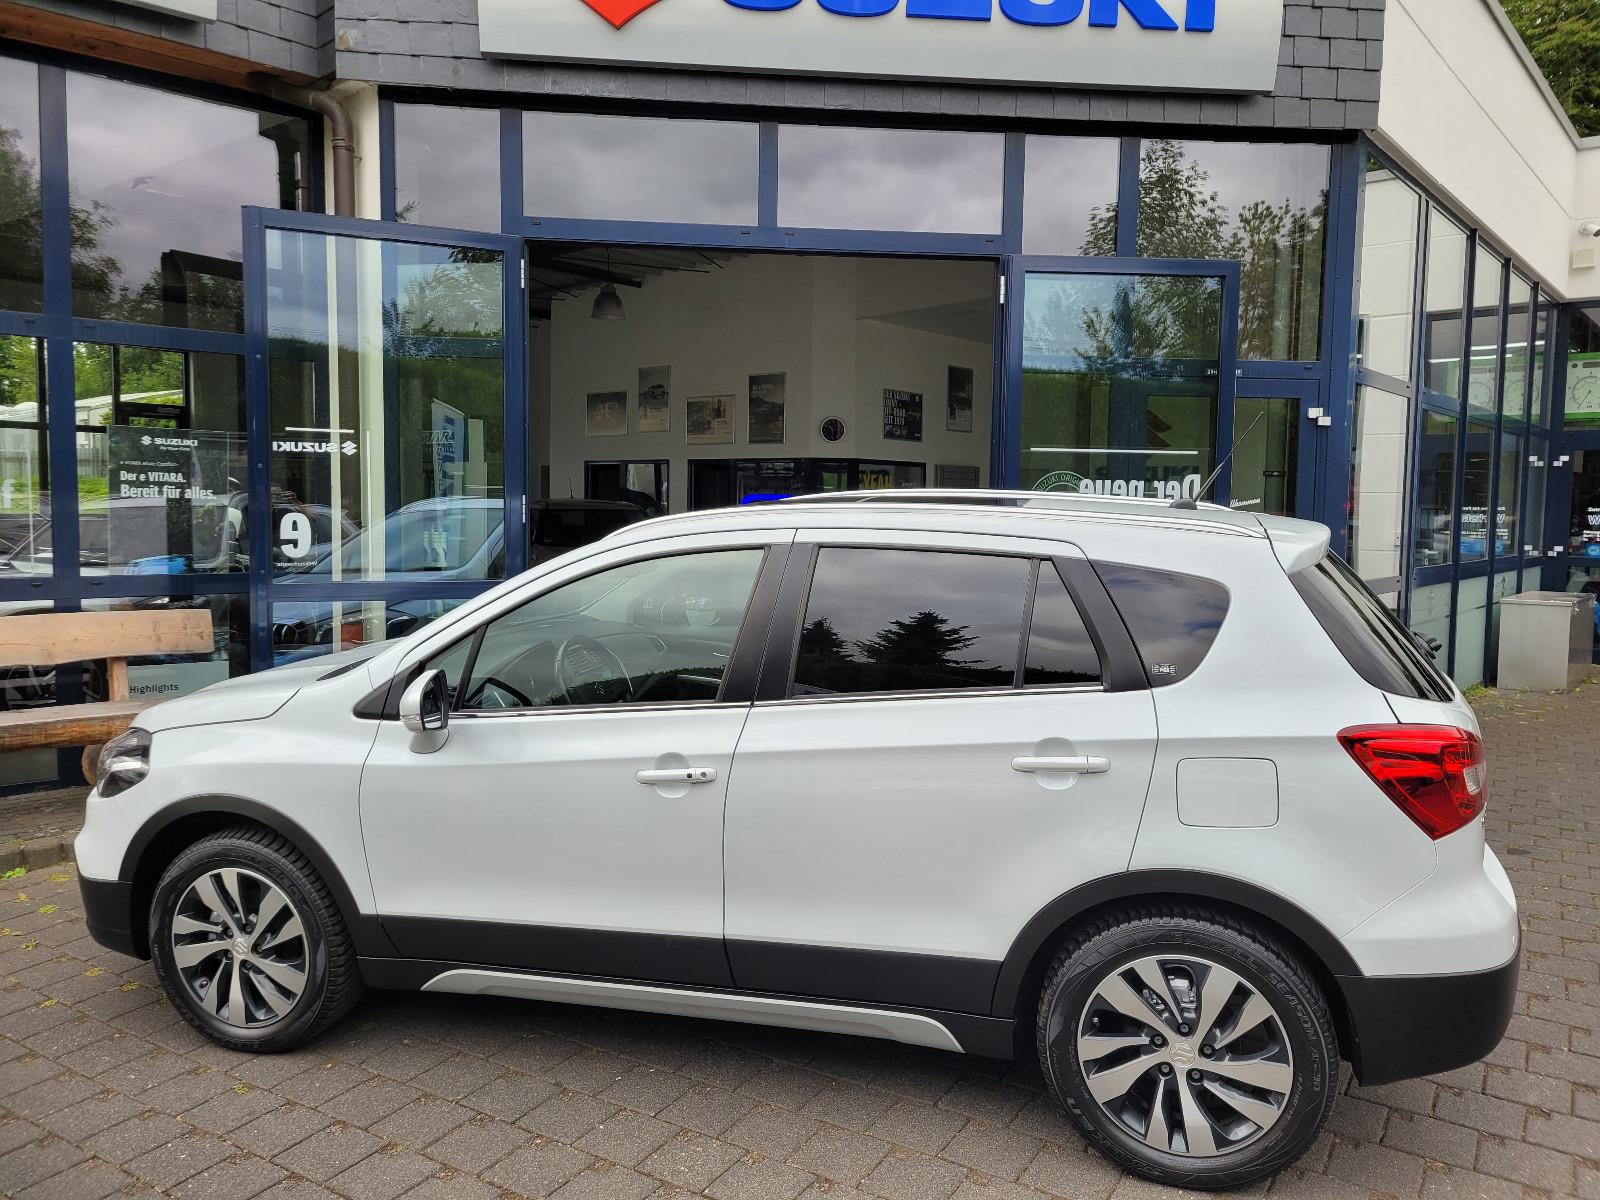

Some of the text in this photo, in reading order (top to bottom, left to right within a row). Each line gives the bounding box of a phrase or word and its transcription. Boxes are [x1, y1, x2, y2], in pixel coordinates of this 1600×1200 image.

[154, 437, 198, 447] SUZUKI
[120, 470, 187, 483] Der e VITARA.
[120, 484, 217, 500] Bereit für alles.
[129, 684, 180, 695] Highlights
